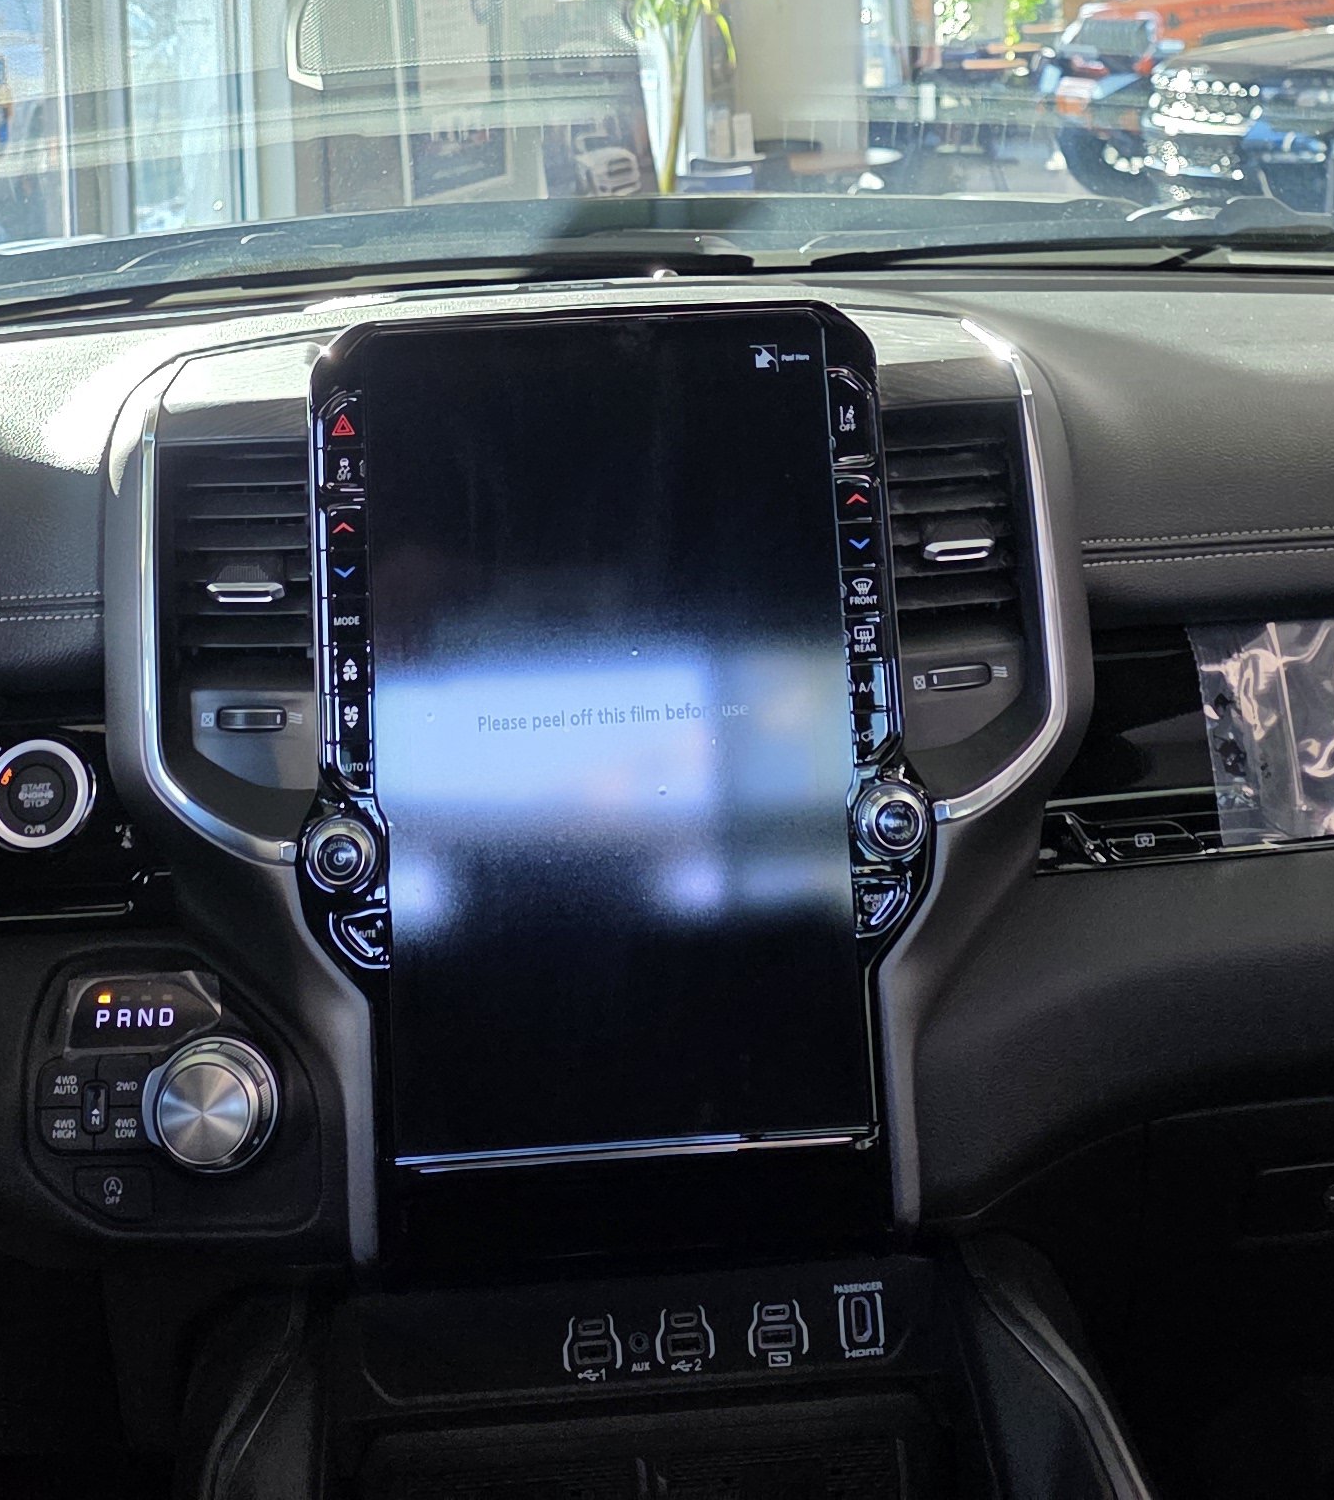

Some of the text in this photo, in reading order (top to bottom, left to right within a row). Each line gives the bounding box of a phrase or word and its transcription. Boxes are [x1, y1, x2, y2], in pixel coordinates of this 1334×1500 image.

[839, 423, 857, 432] OFF
[336, 472, 352, 482] OFF
[849, 595, 878, 605] FRONT
[333, 615, 361, 626] MODE
[854, 643, 877, 653] REAR
[478, 715, 528, 732] Please
[532, 711, 566, 732] peel
[570, 708, 593, 727] off
[598, 705, 626, 725] this
[630, 704, 660, 723] film
[721, 705, 749, 718] use
[20, 782, 52, 792] START
[18, 789, 55, 801] ENGINE
[23, 799, 50, 808] STOP
[55, 1075, 78, 1085] 4WD
[116, 1080, 138, 1091] 2WD
[53, 1084, 79, 1095] AUTO
[54, 1118, 76, 1129] 4WD
[91, 1115, 101, 1126] N
[114, 1118, 137, 1128] 4WD
[52, 1128, 77, 1139] HIGH
[115, 1127, 137, 1138] LOW
[104, 1196, 121, 1205] OFF
[834, 1280, 883, 1294] PASSENGER
[845, 1346, 884, 1359] HDMI
[631, 1362, 651, 1373] AUX
[694, 1358, 702, 1372] 2
